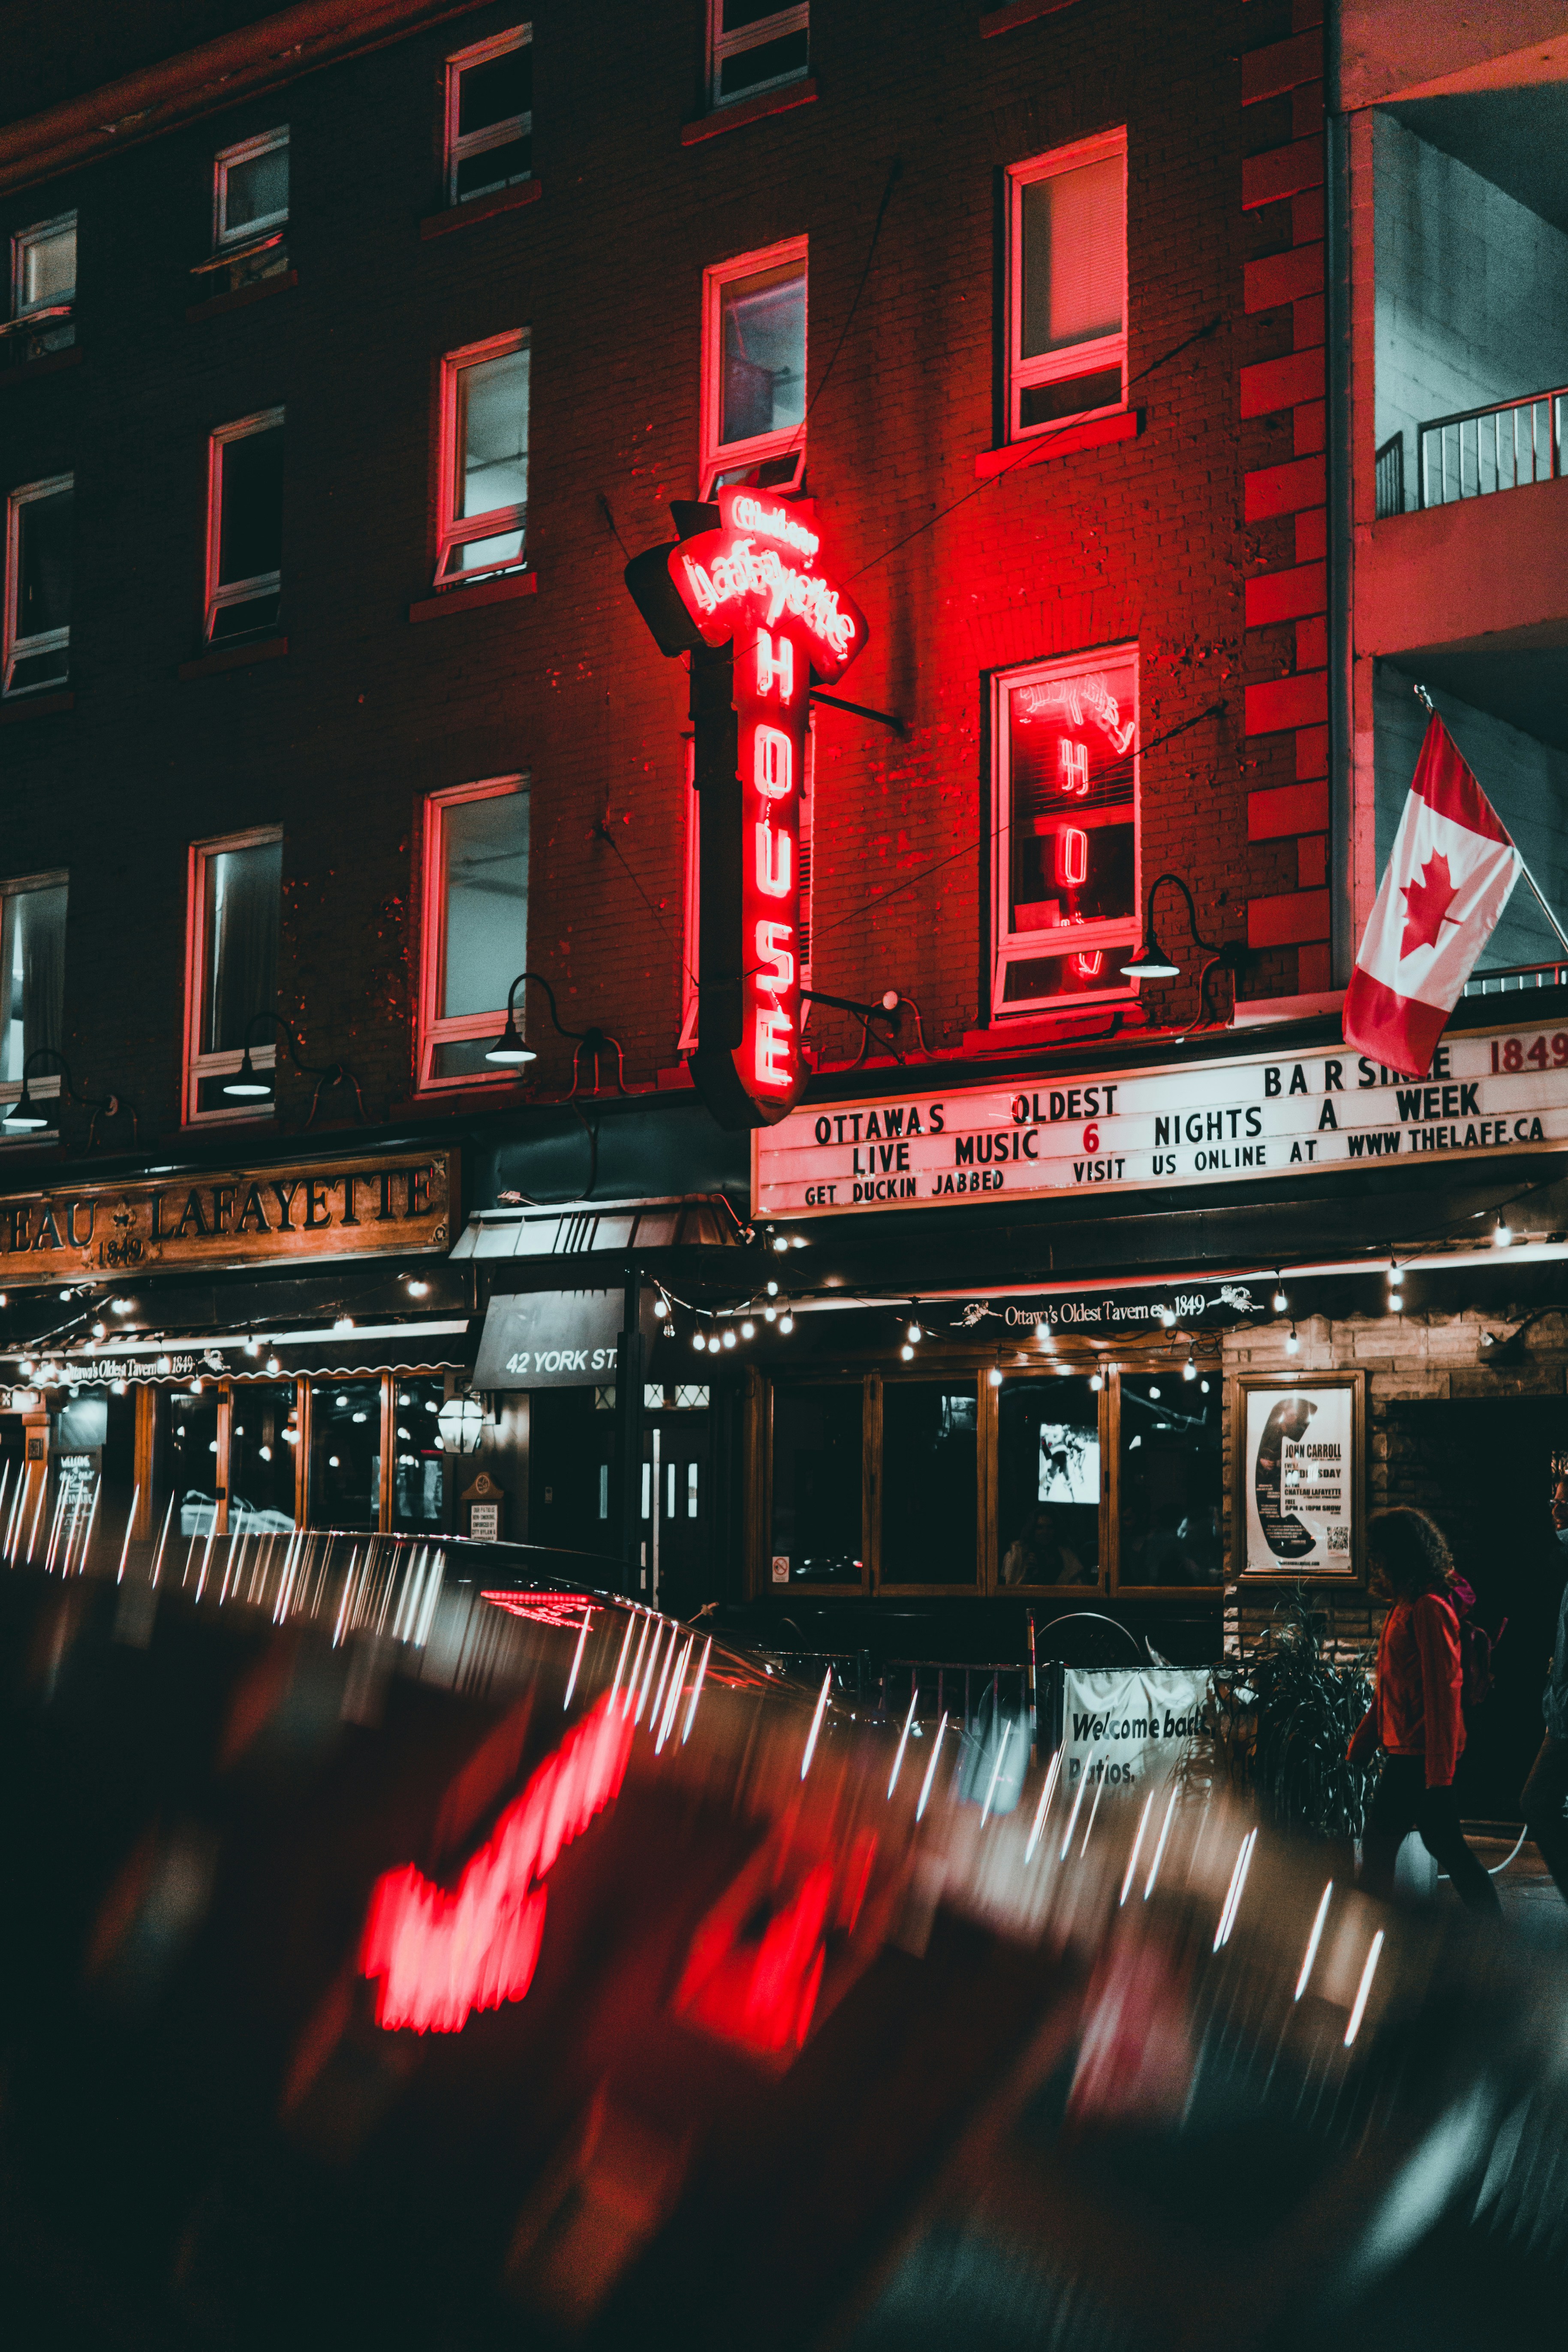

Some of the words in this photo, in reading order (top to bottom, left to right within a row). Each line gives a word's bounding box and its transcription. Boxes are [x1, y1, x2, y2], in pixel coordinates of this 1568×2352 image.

[753, 627, 794, 1086] HOUSE
[815, 1104, 943, 1144] OTTAWAS
[1012, 1086, 1117, 1124] OLDEST
[1265, 1060, 1343, 1097] BAR
[1491, 1032, 1568, 1074] 1849
[853, 1143, 909, 1175] LIVE
[956, 1130, 1038, 1165] MUSIC
[1083, 1123, 1099, 1154] 6
[1155, 1107, 1261, 1146] NIGHTS
[1318, 1099, 1338, 1131] A
[1396, 1083, 1481, 1122] WEEK
[805, 1185, 836, 1206] GET
[853, 1178, 915, 1202] DUCKIN
[932, 1170, 1003, 1195] JABBED
[1074, 1159, 1125, 1182] VISIT
[1153, 1154, 1176, 1175] US
[1195, 1145, 1266, 1171] ONLINE
[1290, 1140, 1317, 1162] AT
[149, 1166, 434, 1240] LAFAYETTE
[99, 1238, 143, 1266] 1849
[1060, 1303, 1102, 1323] Oldest
[1103, 1301, 1149, 1320] Tavern
[1174, 1294, 1205, 1317] 1849
[172, 1355, 193, 1374] 1849
[506, 1353, 530, 1373] 42
[534, 1350, 589, 1372] YORK
[591, 1349, 617, 1370] ST.
[1285, 1444, 1305, 1458] JOHN
[1307, 1444, 1342, 1458] CARROLL
[1073, 1711, 1159, 1741] Welcome
